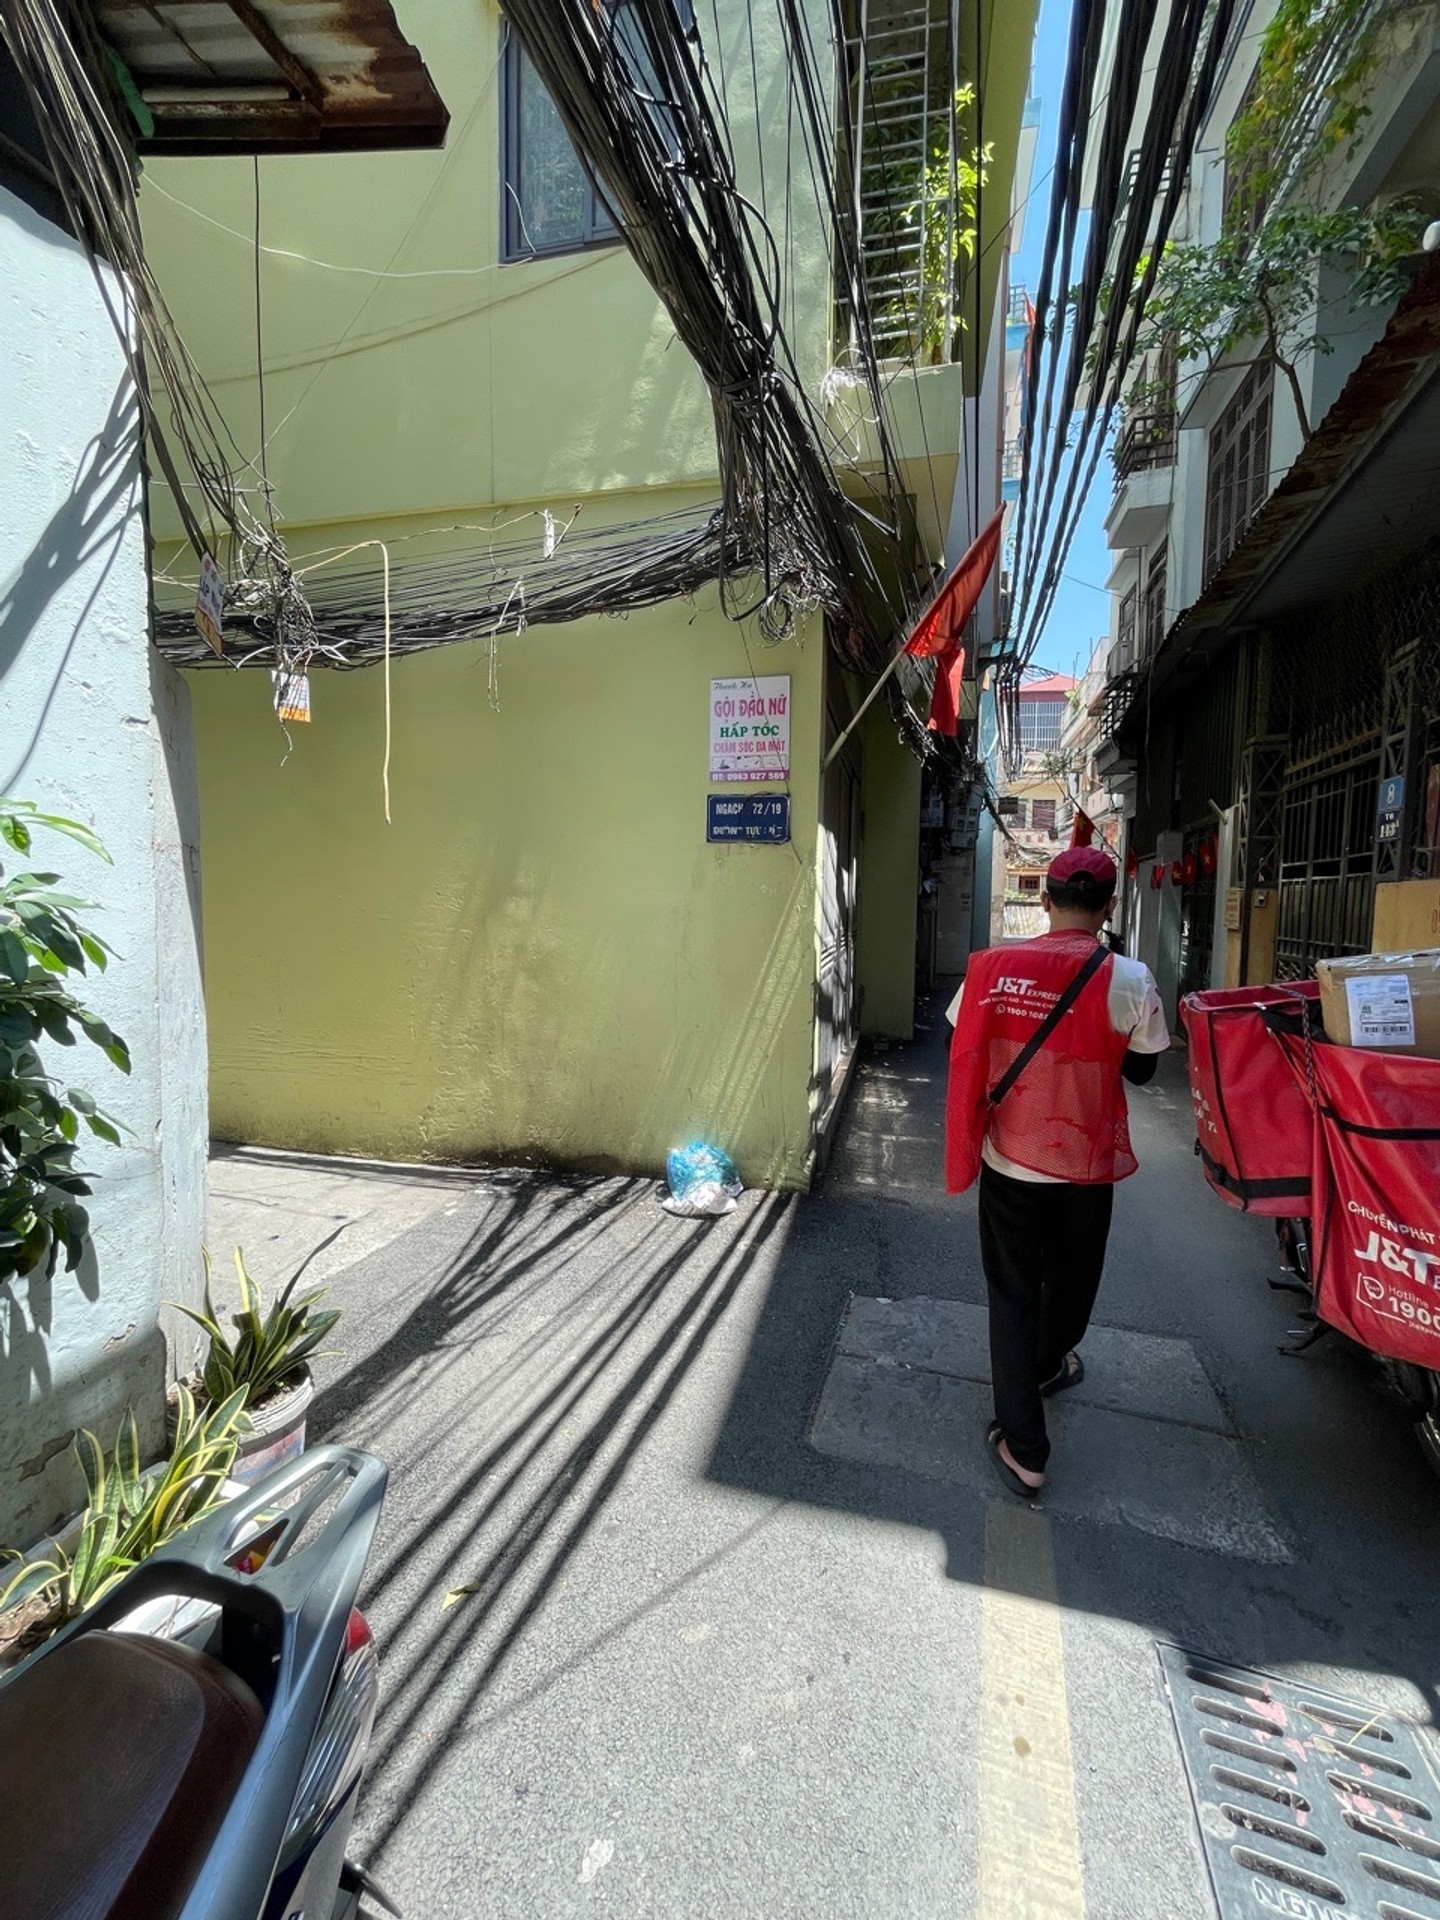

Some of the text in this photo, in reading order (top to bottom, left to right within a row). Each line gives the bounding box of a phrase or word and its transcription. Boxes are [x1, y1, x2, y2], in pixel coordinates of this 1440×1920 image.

[720, 721, 780, 738] HẤP TÓC
[756, 740, 766, 752] DA
[1387, 783, 1395, 804] 8
[989, 976, 1062, 1002] J&T EXPRESS
[1399, 1223, 1436, 1245] PHÁT
[1353, 1230, 1440, 1285] J&T
[1388, 1285, 1430, 1309] Hotline
